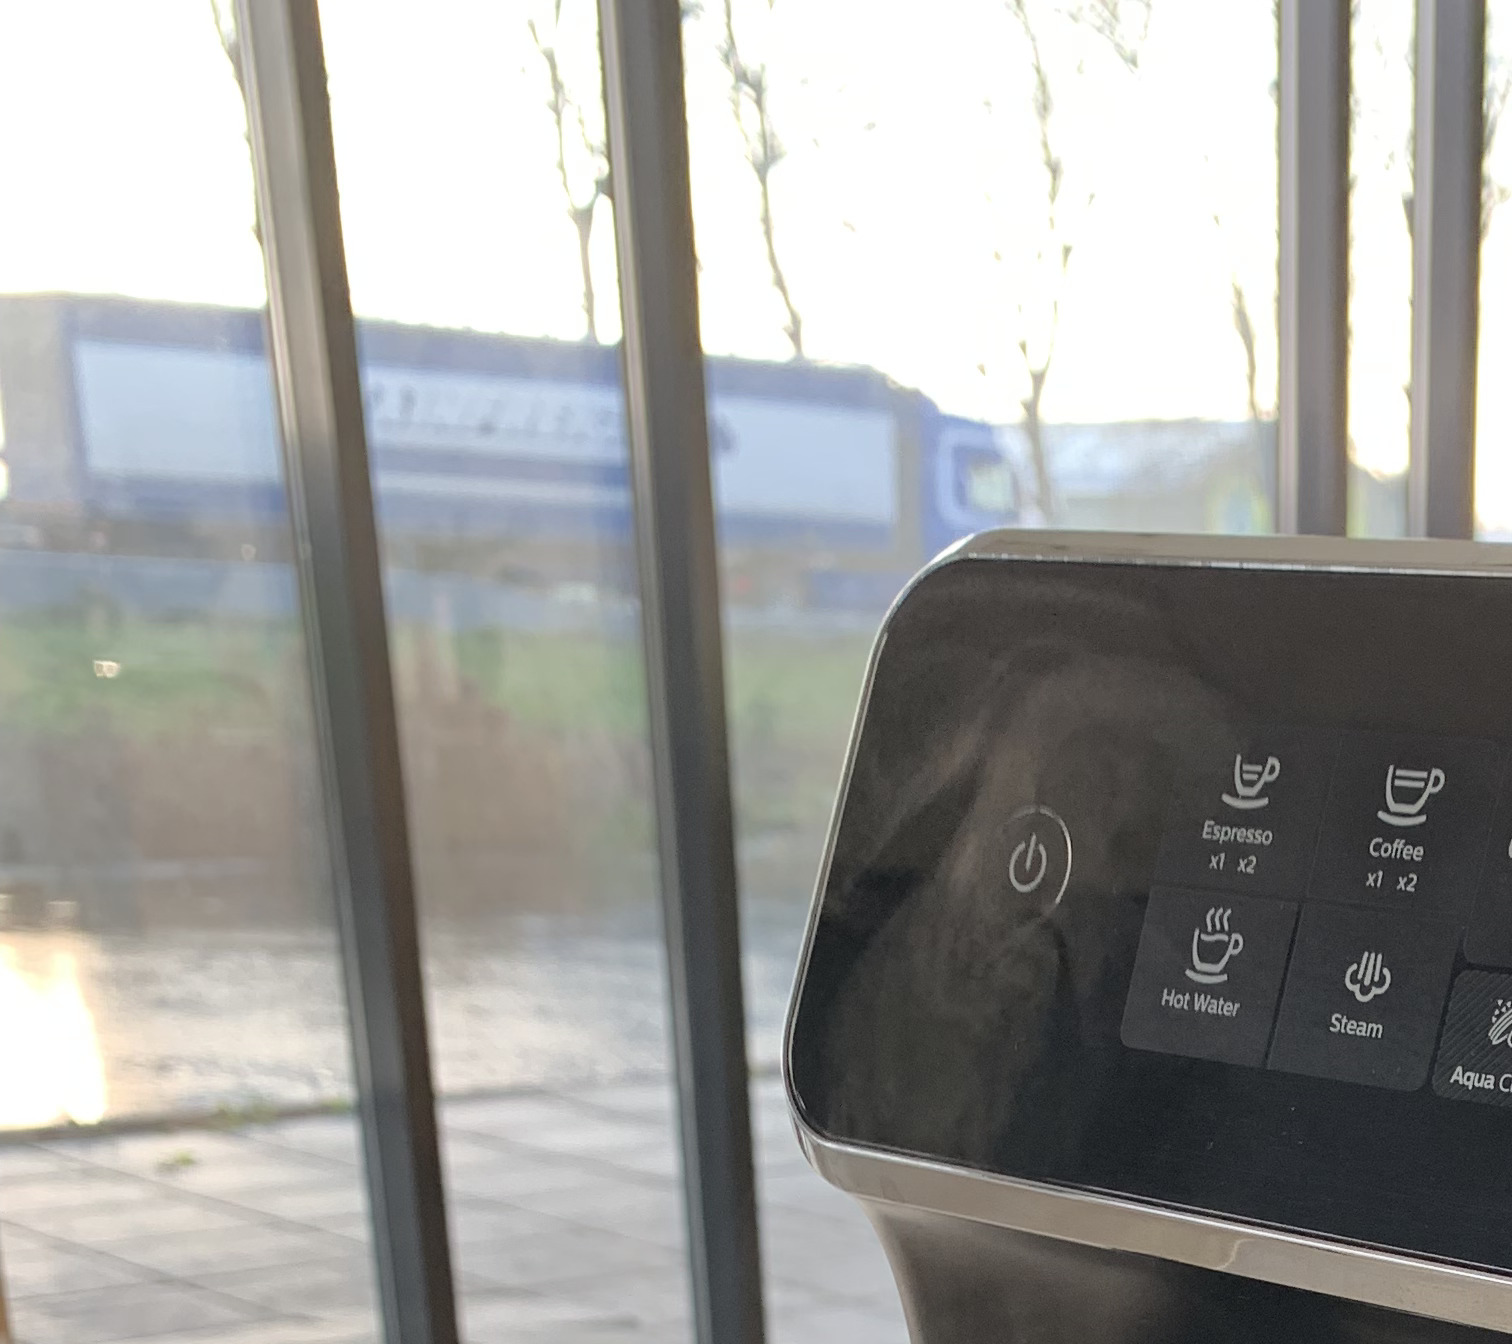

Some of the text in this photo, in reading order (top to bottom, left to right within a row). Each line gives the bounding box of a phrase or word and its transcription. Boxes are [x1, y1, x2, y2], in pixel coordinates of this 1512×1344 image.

[1201, 819, 1273, 846] Espresso
[1369, 837, 1424, 862] Coffee
[1209, 852, 1257, 874] x1 x2
[1365, 870, 1418, 893] x1 x2
[1161, 988, 1241, 1017] Hot Water
[1329, 1012, 1383, 1039] Steam
[1449, 1065, 1495, 1090] Aqua
